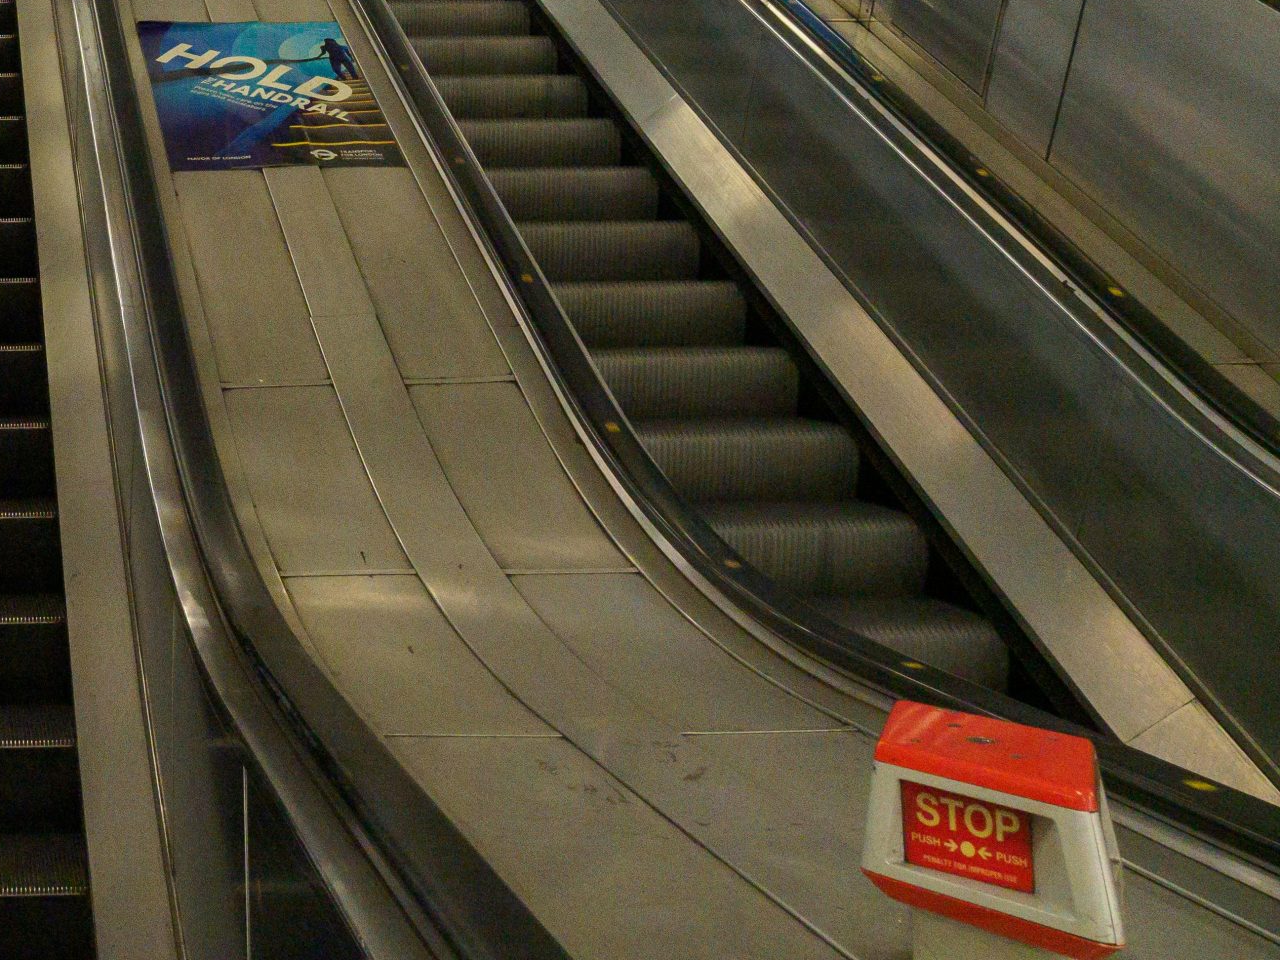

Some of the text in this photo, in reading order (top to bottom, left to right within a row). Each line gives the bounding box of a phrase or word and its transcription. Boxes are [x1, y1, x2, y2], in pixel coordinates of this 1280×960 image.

[155, 42, 353, 103] HOLD
[212, 80, 351, 122] HANDRAIL
[915, 791, 1020, 842] STOP
[911, 831, 1028, 869] PUSH PUSH
[922, 854, 952, 868] PENALTY
[953, 861, 968, 871] FOR
[968, 865, 1003, 881] IMPROPER
